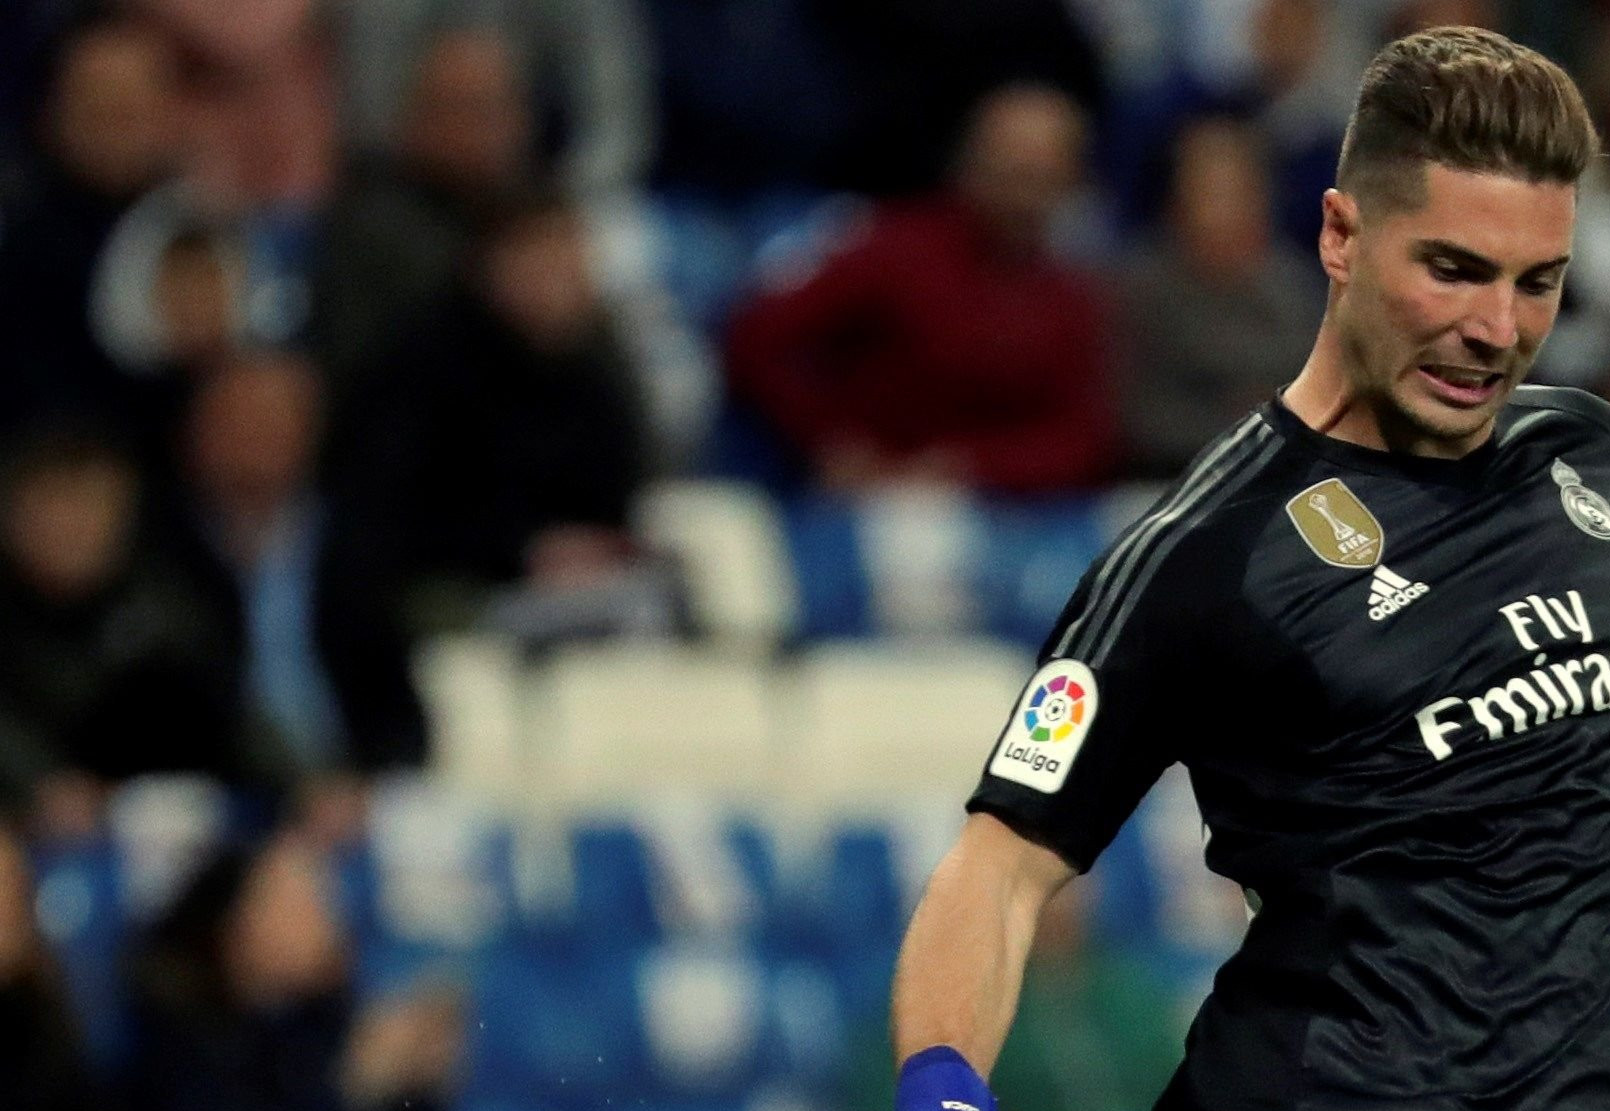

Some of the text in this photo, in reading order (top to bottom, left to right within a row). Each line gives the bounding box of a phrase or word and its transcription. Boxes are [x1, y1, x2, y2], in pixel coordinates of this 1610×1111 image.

[1337, 533, 1370, 554] FIFA
[1368, 582, 1430, 620] adidas
[1498, 590, 1594, 651] Fly
[1004, 742, 1061, 774] LaLiga
